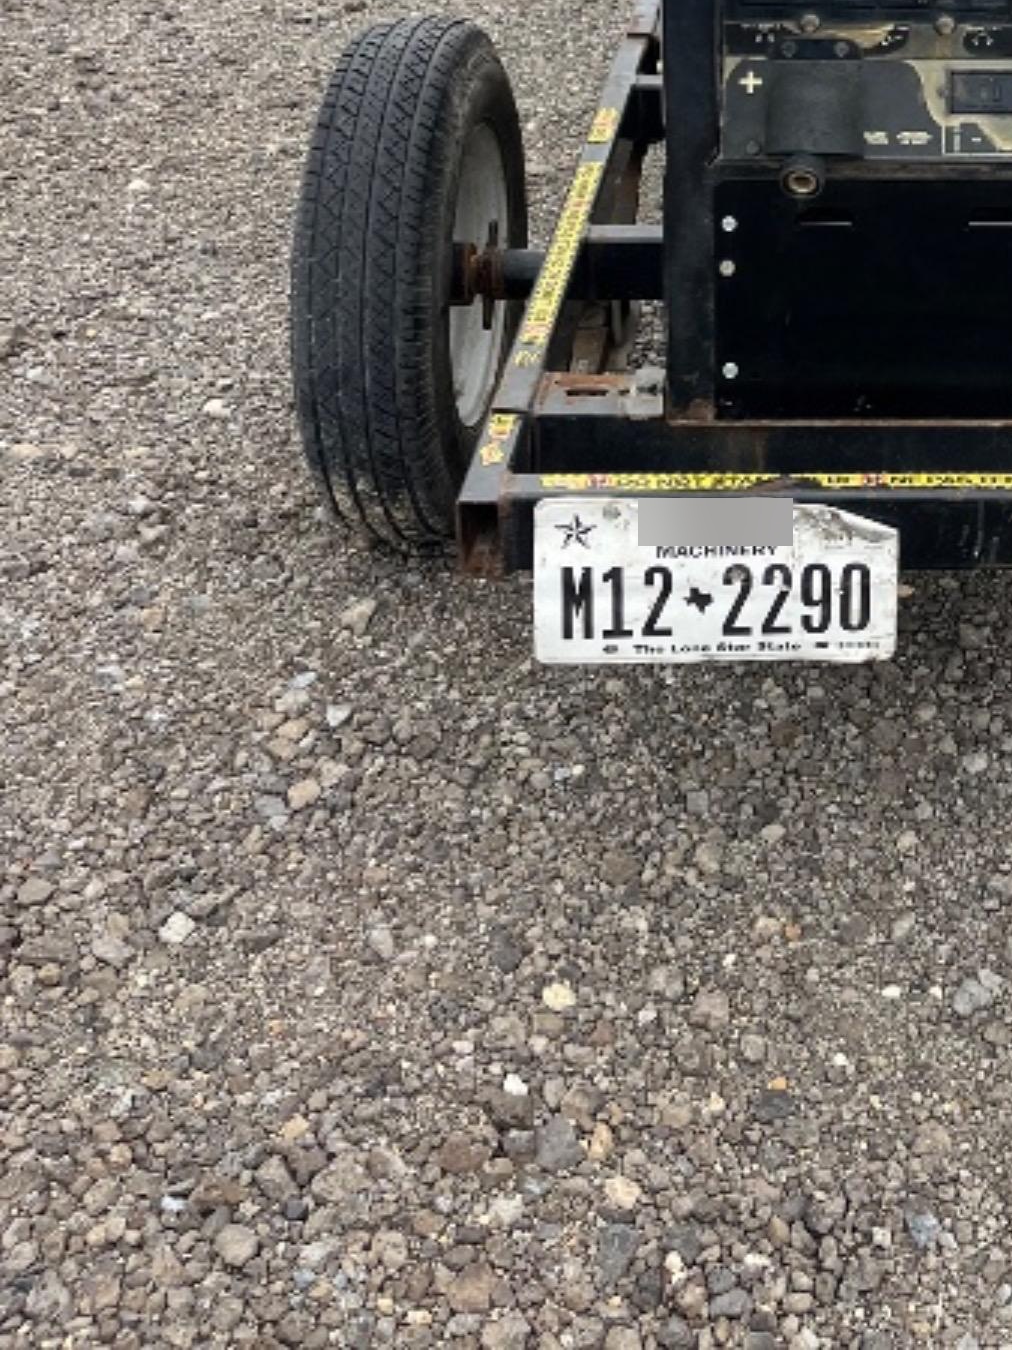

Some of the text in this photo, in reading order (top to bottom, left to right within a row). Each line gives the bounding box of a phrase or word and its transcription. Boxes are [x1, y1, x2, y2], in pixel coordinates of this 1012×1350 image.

[655, 545, 777, 559] MACHINERY
[560, 562, 872, 640] M12 2290
[633, 640, 802, 654] The Lone Star State
